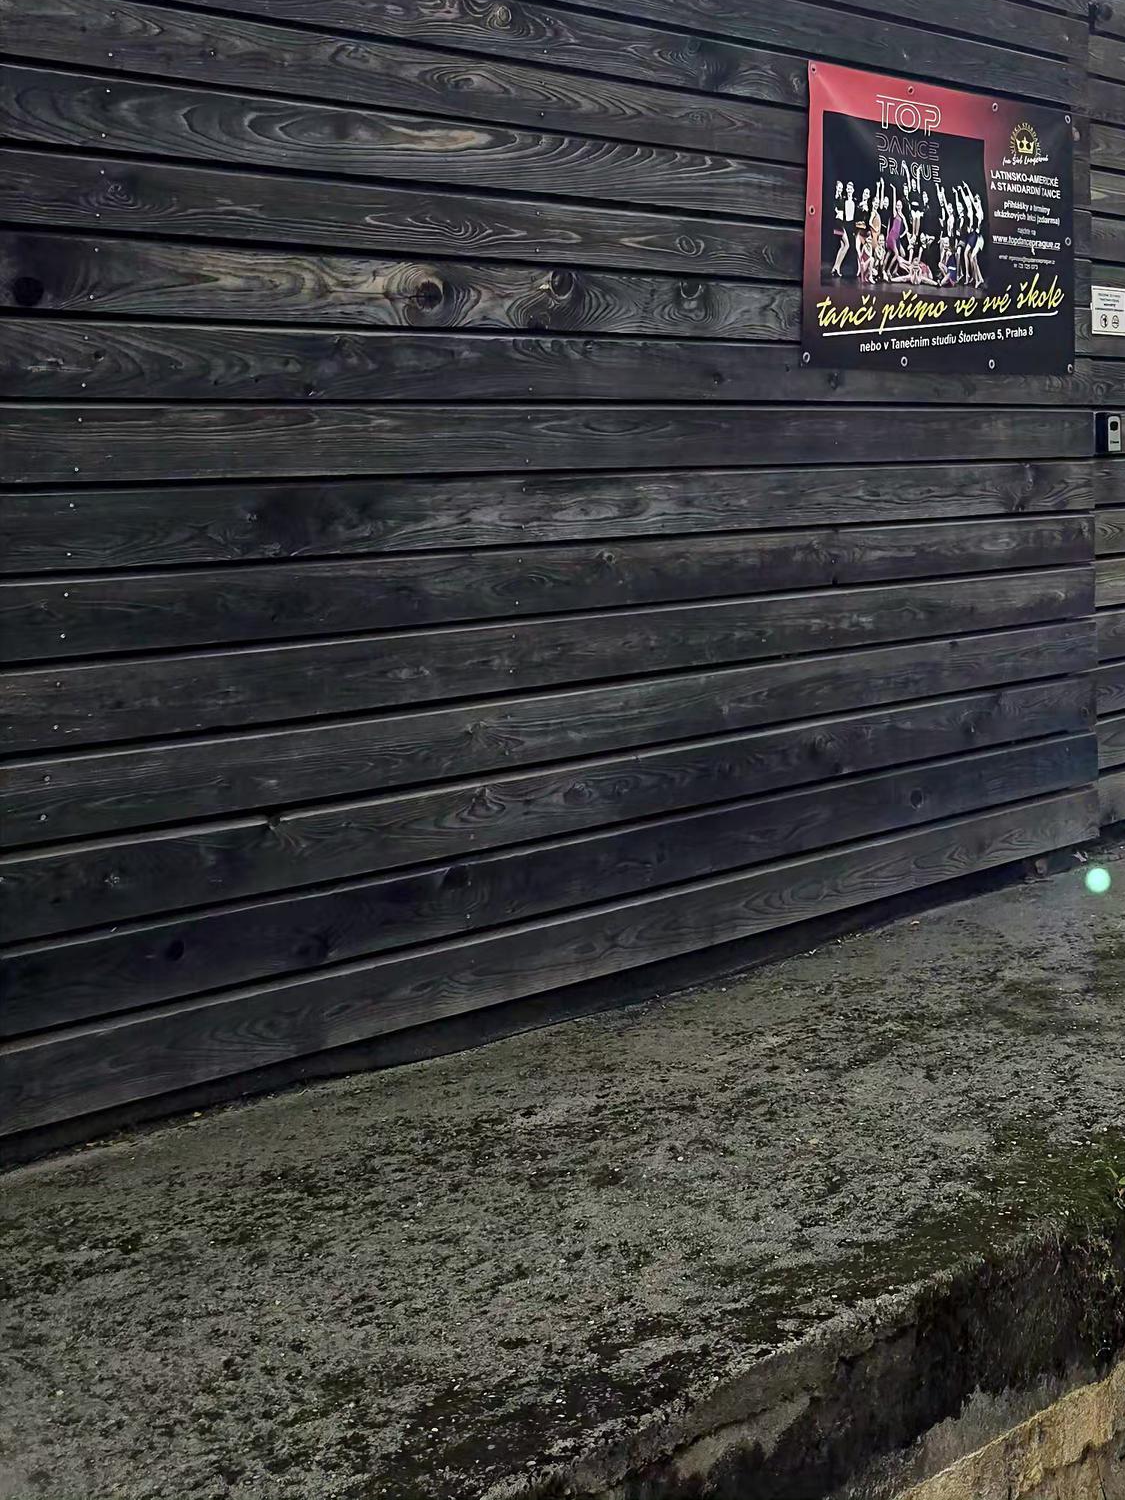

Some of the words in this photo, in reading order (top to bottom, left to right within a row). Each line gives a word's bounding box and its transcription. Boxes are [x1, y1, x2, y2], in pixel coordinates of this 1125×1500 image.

[876, 94, 941, 136] TOP
[875, 132, 939, 161] DANCE
[990, 169, 1059, 187] LATINSKO-AMERICKÉ
[990, 181, 997, 190] A
[997, 182, 1041, 196] STANDARDNÍ
[1041, 187, 1061, 199] TANCE
[879, 289, 948, 335] přímo
[954, 296, 978, 317] ve
[982, 285, 1012, 313] své
[1017, 273, 1065, 309] škole
[860, 340, 881, 352] nebo
[884, 342, 889, 350] v
[931, 333, 957, 346] studiu
[958, 330, 996, 343] Štorchova
[1005, 327, 1028, 338] Praha
[1028, 325, 1034, 336] 8
